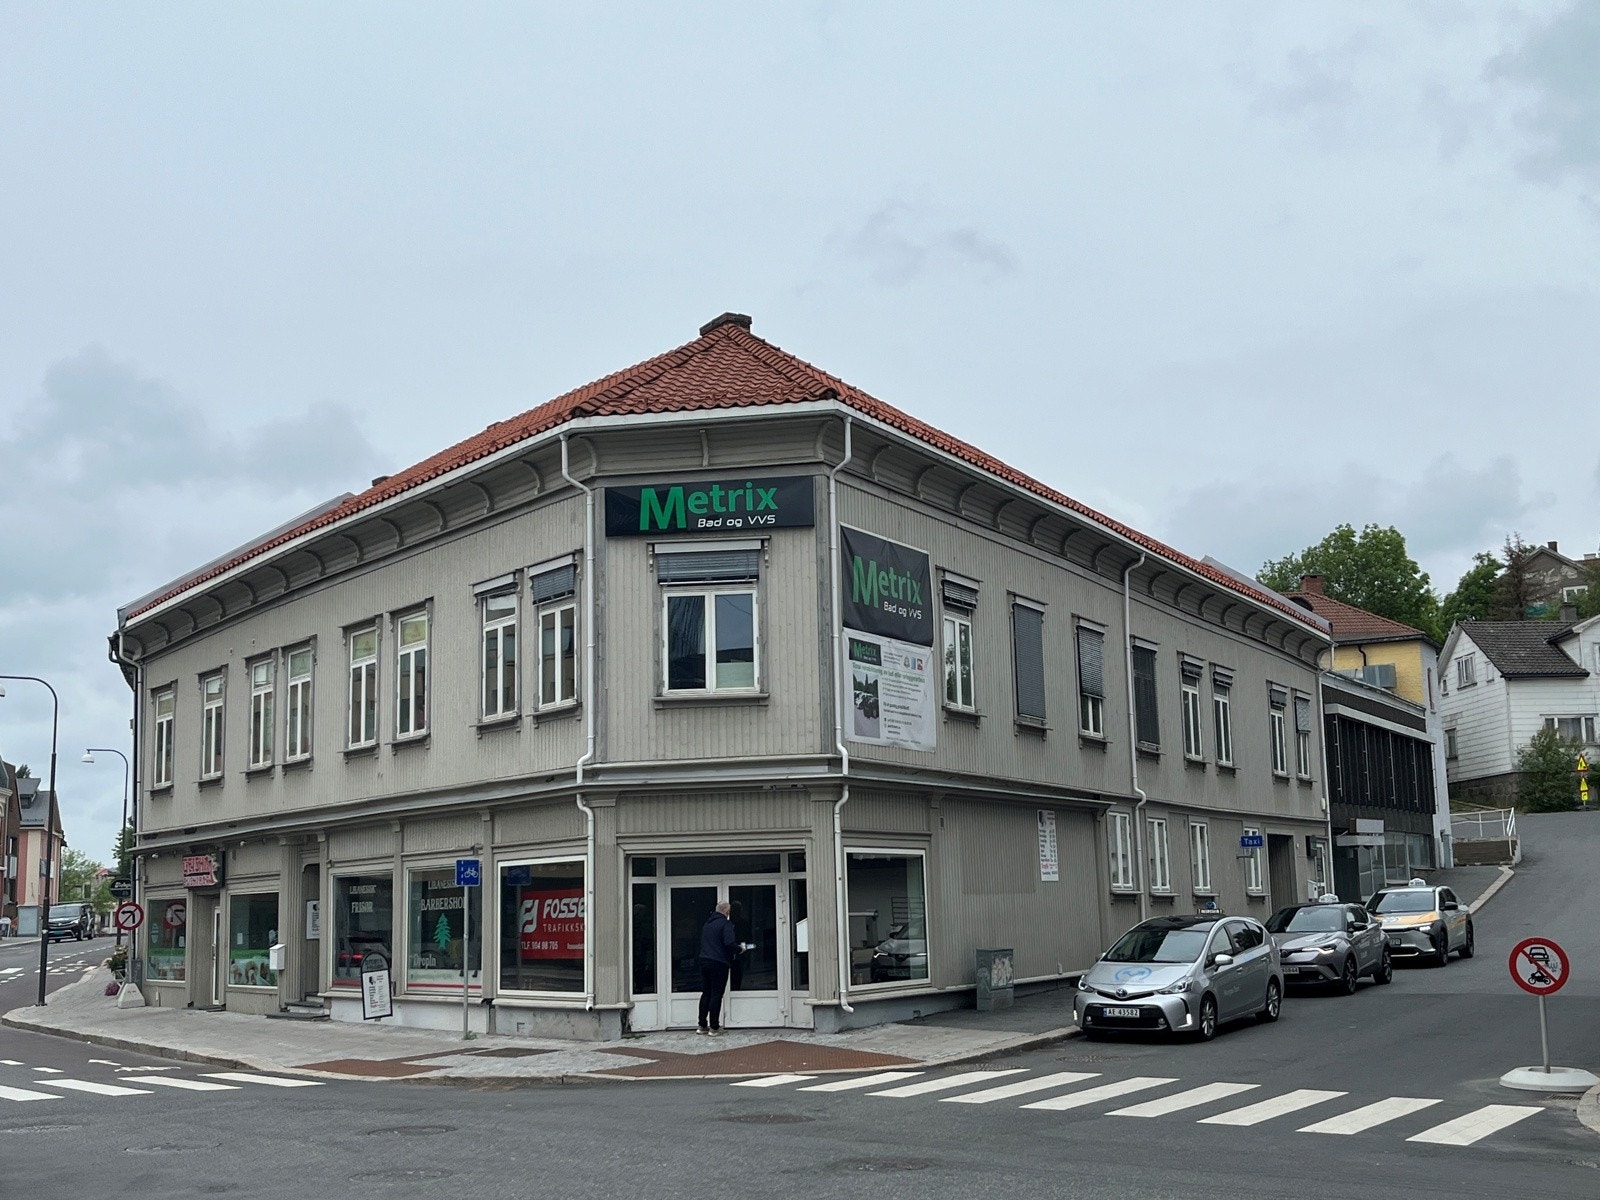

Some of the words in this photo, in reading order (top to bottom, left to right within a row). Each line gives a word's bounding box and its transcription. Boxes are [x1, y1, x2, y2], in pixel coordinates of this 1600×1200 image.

[640, 482, 778, 530] Metrix
[697, 518, 722, 528] Bad
[727, 518, 743, 528] og
[747, 515, 776, 525] VVS
[853, 555, 922, 608] Metrix
[883, 601, 897, 613] Bad
[898, 607, 907, 618] og
[909, 608, 922, 620] VVS
[1243, 837, 1261, 845] Taxi
[421, 896, 465, 911] BARBERSHO
